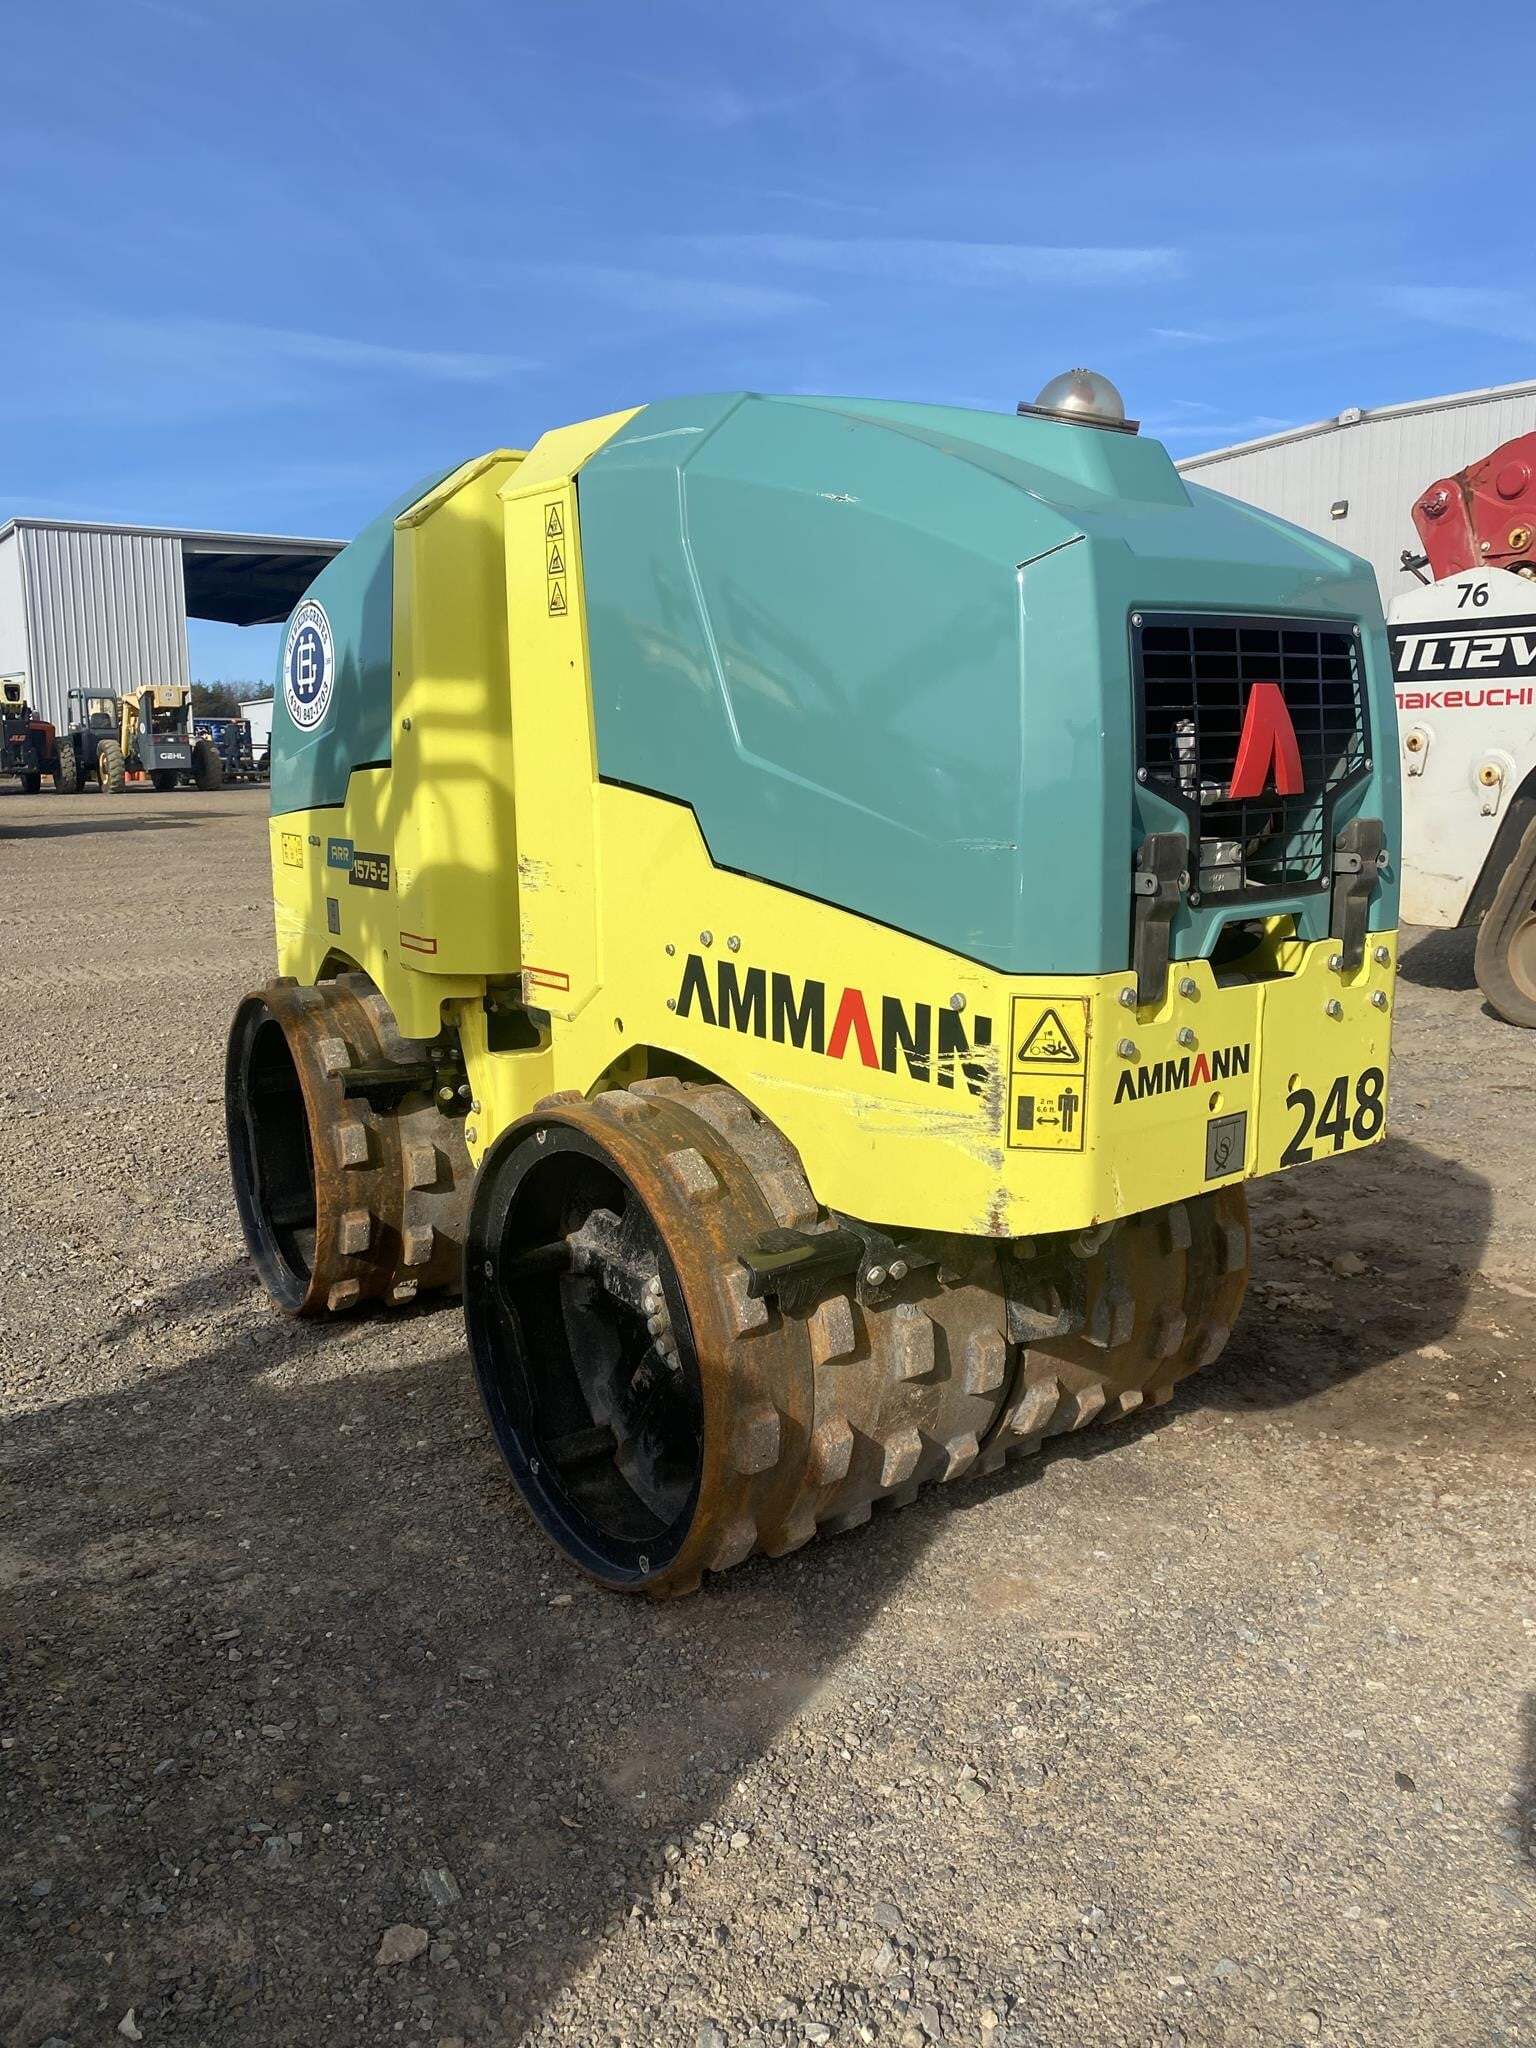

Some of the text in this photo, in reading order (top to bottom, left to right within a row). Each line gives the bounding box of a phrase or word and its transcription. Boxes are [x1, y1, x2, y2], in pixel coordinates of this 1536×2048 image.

[1457, 583, 1489, 608] 76
[160, 752, 186, 760] GEHL
[331, 846, 389, 883] ARR 1575-2
[675, 953, 993, 1097] AMMANN
[1113, 1043, 1250, 1104] AMMANN
[1279, 1066, 1385, 1168] 248
